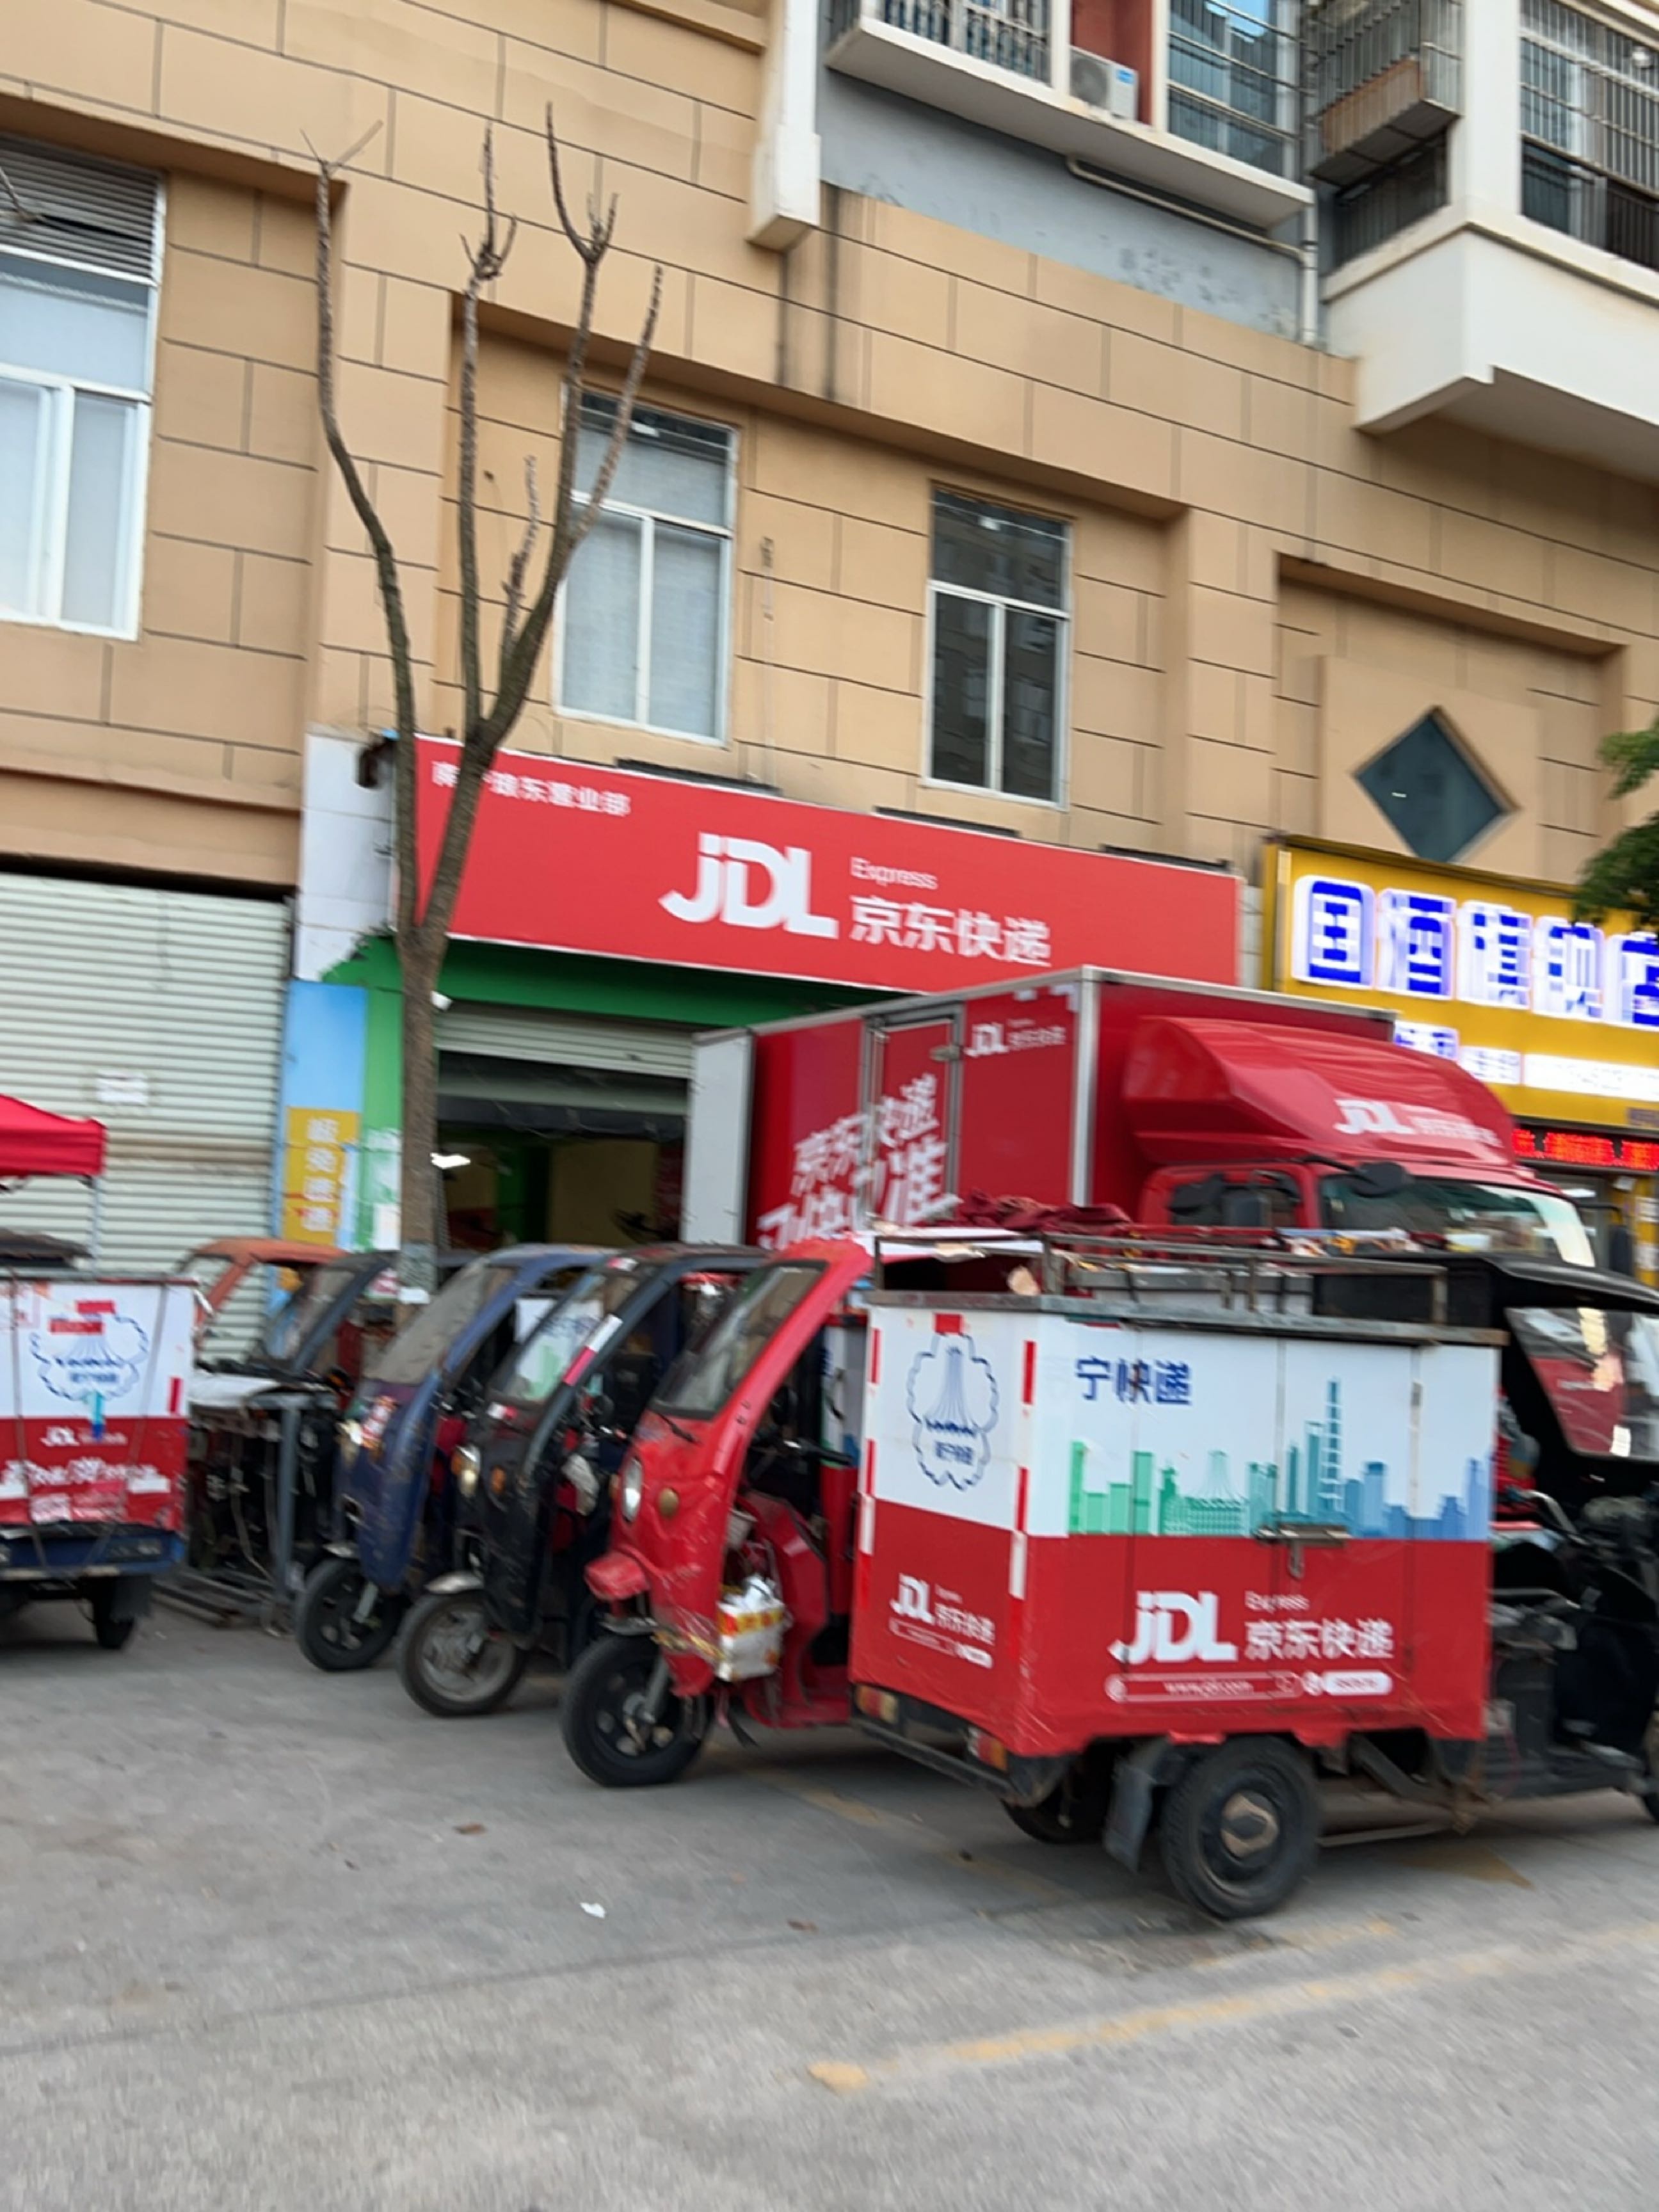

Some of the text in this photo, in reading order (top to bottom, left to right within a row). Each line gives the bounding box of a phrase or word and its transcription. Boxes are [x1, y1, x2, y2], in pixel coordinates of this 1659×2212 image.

[659, 830, 838, 940] JDL
[850, 856, 938, 890] Express
[849, 895, 1052, 968] 京东快递
[1075, 1354, 1192, 1407] 宁快递
[1108, 1590, 1238, 1664] JDL
[1244, 1617, 1395, 1660] 京东快递
